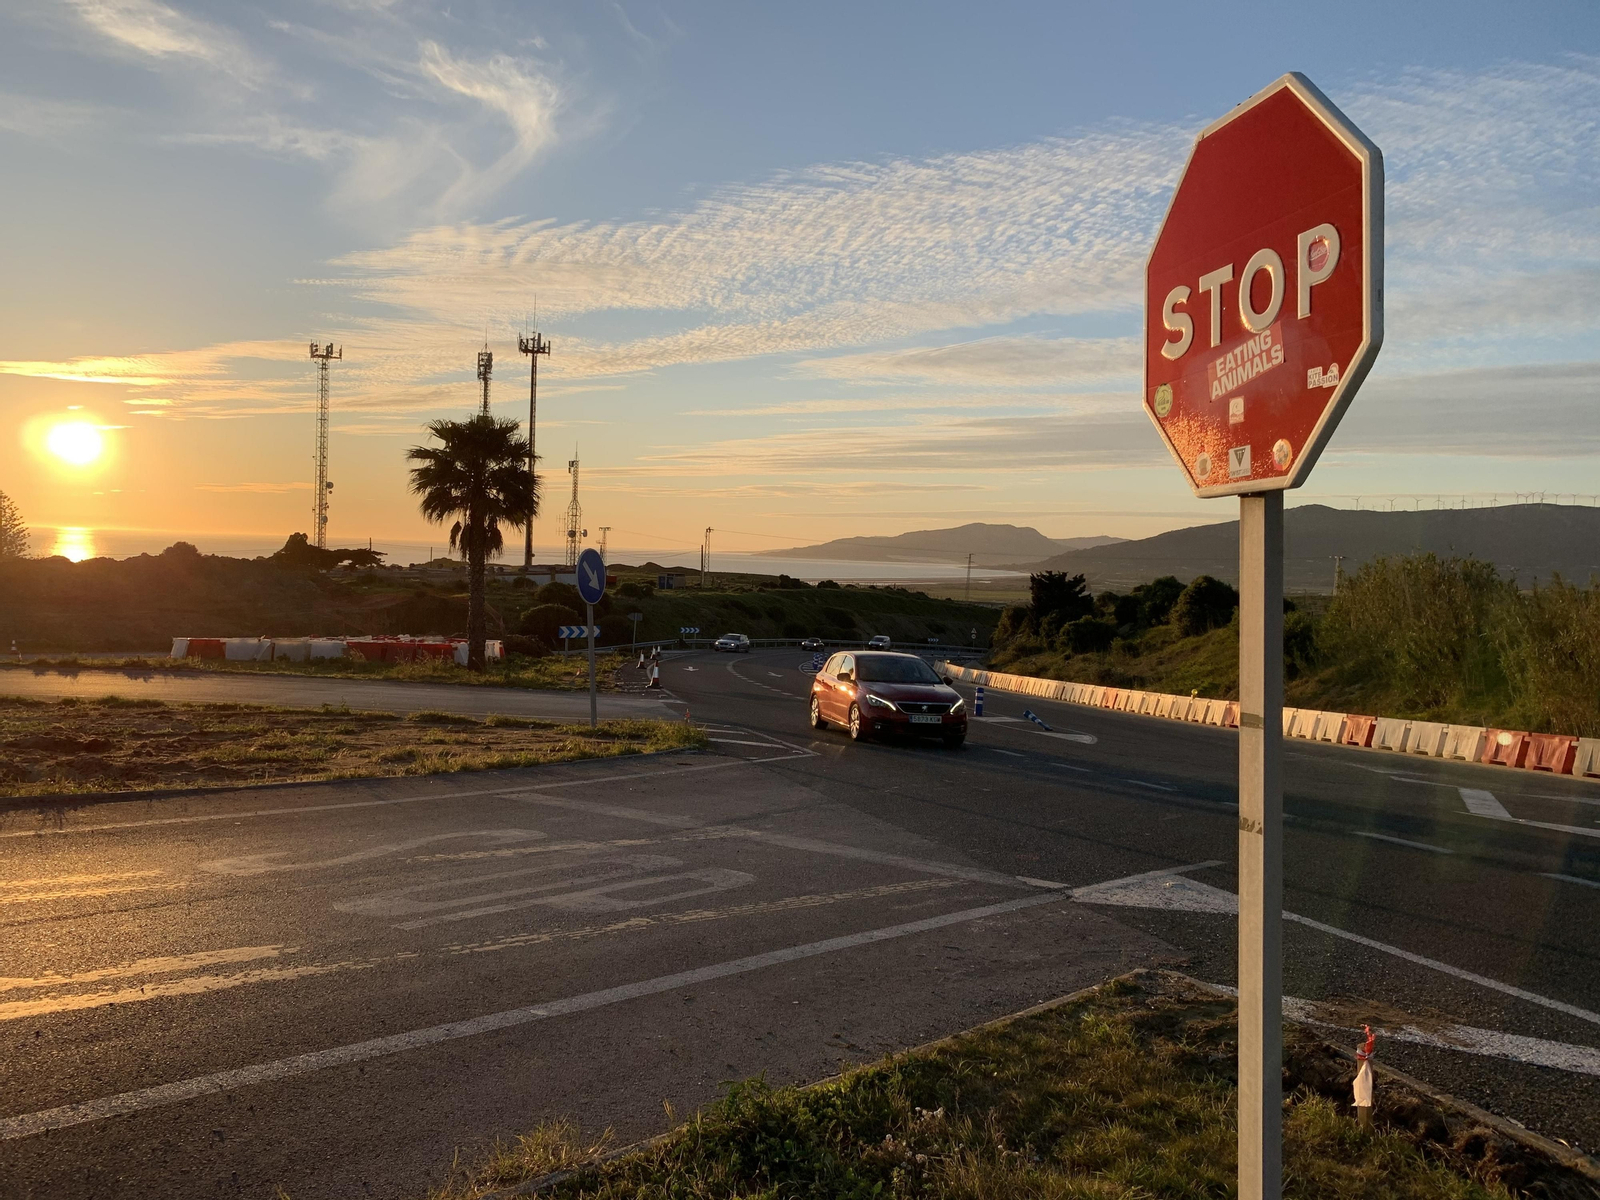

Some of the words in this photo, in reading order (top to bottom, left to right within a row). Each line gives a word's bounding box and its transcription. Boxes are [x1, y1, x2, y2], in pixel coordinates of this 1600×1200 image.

[1161, 223, 1340, 360] STOP
[1211, 344, 1283, 400] ANIMALS
[1215, 329, 1272, 377] EATING
[1308, 371, 1322, 380] KITE
[1308, 374, 1338, 388] PASSION
